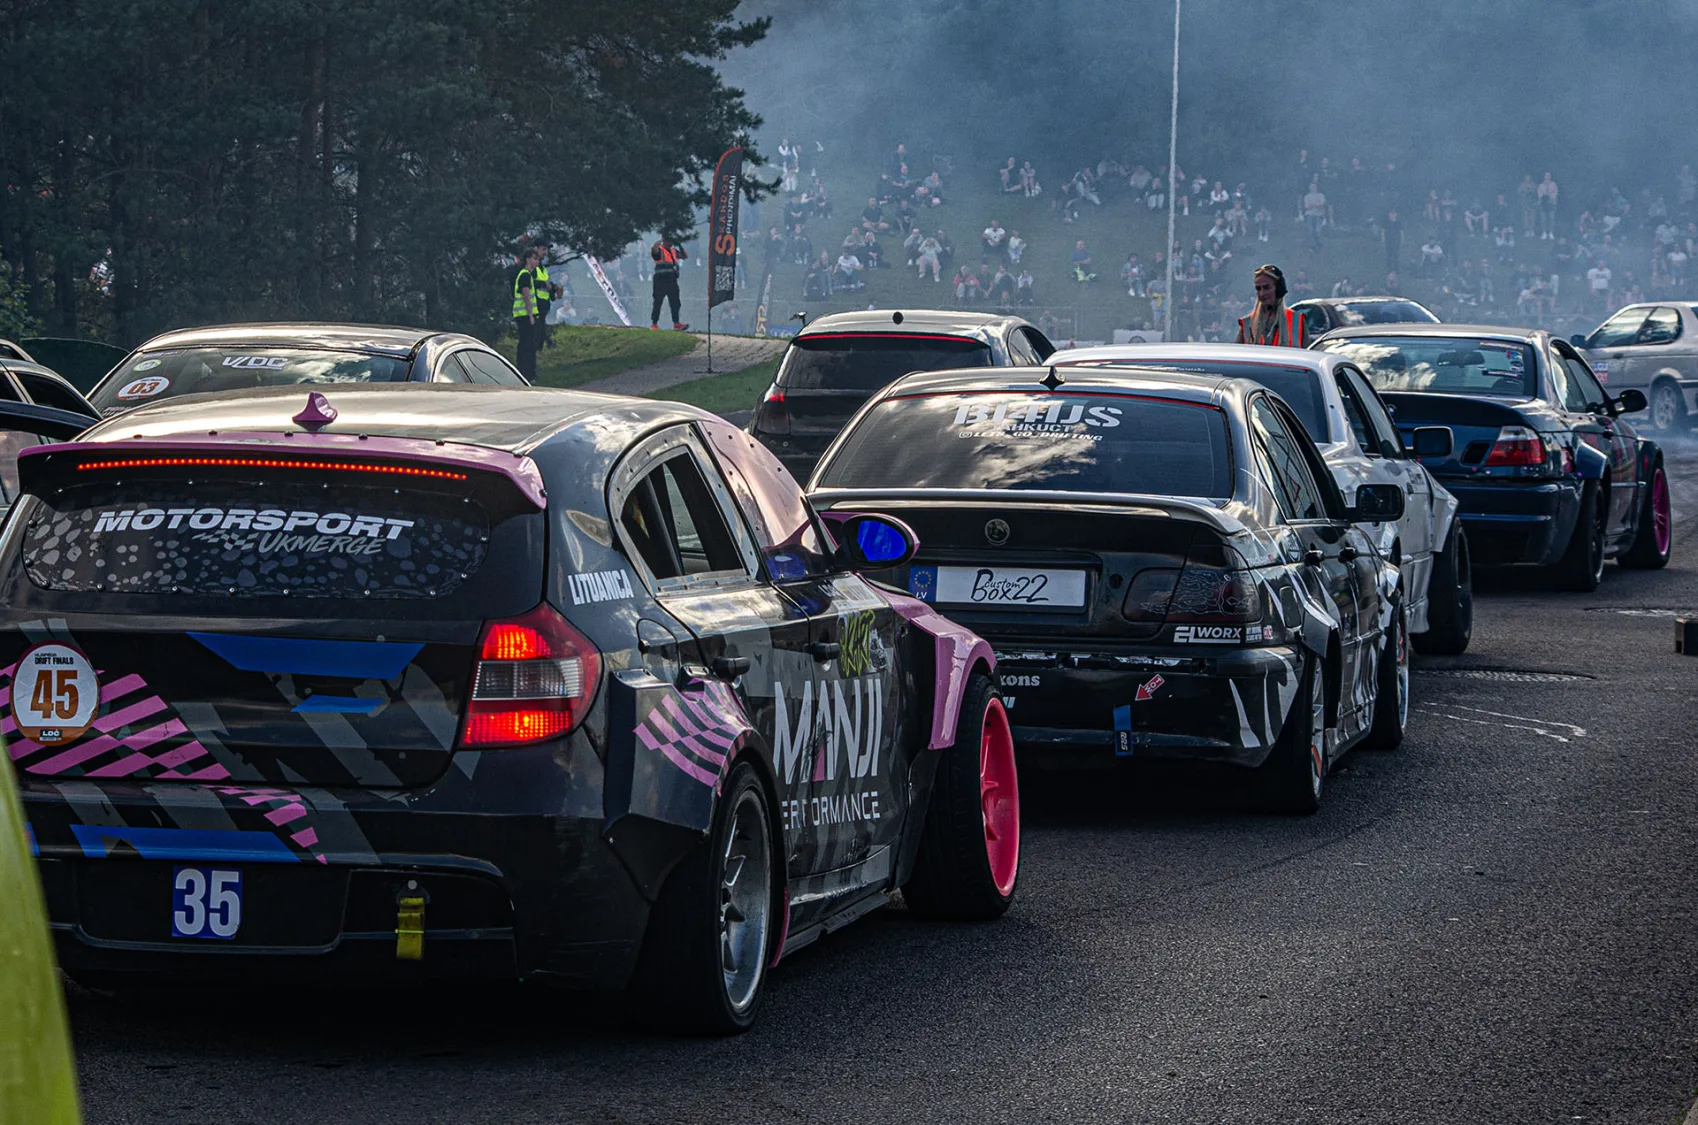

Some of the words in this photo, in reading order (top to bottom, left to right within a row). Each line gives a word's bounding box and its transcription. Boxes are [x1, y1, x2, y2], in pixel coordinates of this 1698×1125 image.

[127, 381, 160, 395] 03
[93, 508, 414, 540] MOTORSPORT
[567, 569, 634, 605] LITUANICA
[916, 591, 928, 599] LV
[35, 657, 51, 665] DRIFT
[53, 657, 74, 665] FINALS
[31, 670, 78, 719] 45
[773, 679, 882, 784] MANJI
[174, 868, 240, 937] 35
